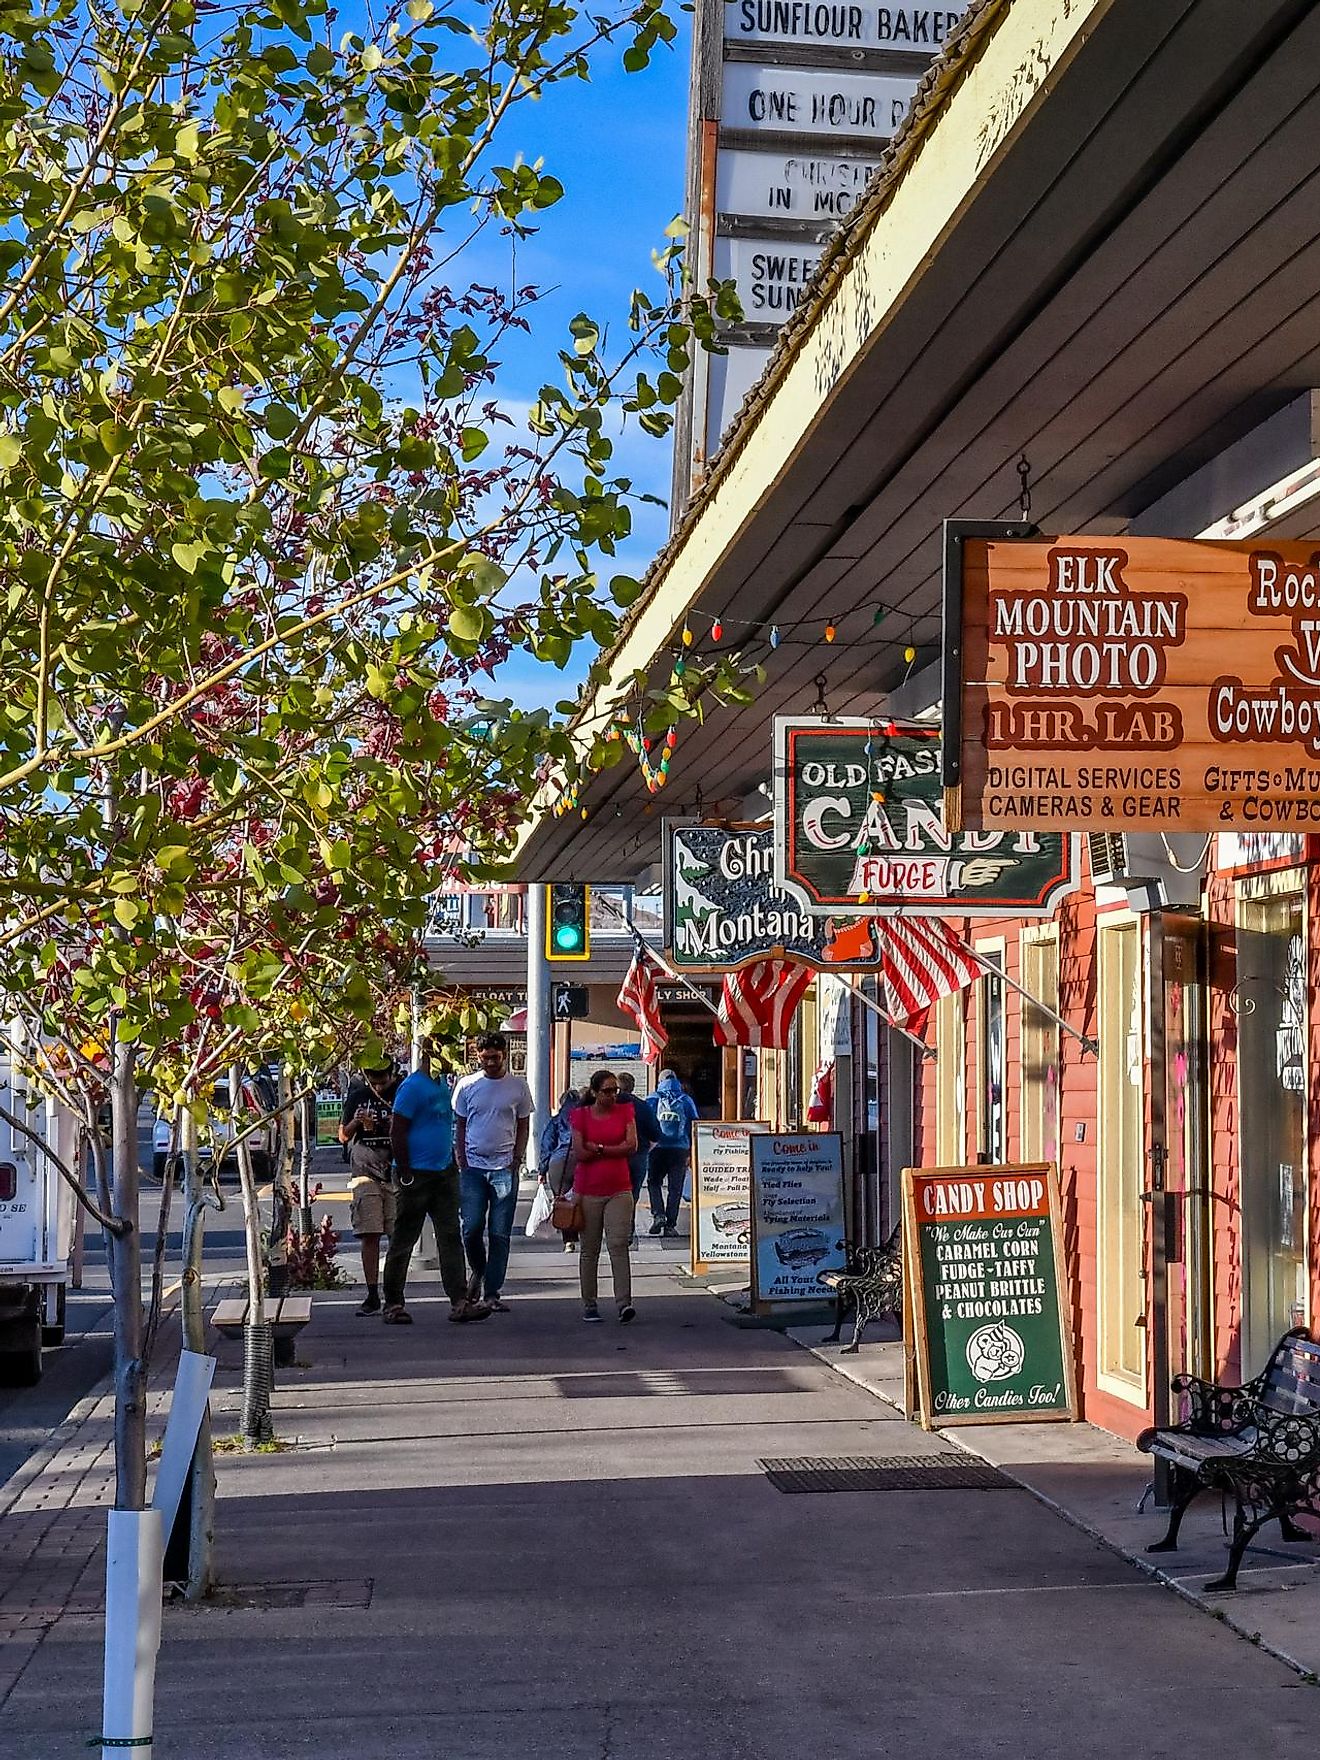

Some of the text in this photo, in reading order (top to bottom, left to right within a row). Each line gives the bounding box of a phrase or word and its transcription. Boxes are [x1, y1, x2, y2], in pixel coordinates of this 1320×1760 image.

[740, 0, 961, 44] SUNFLOUR BAKER
[749, 90, 798, 122] ONE
[812, 93, 875, 128] HOUR
[769, 187, 791, 210] IN
[1056, 556, 1120, 595] ELK
[994, 599, 1179, 638] MOUNTAIN
[1015, 642, 1158, 690] PHOTO
[990, 710, 1175, 743] 1 HR. LAB
[801, 762, 867, 788] OLD
[989, 767, 1182, 790] DIGITAL SERVICES
[1204, 767, 1271, 792] GIFTS
[989, 795, 1182, 818] CAMERAS & GEAR
[1219, 802, 1235, 823] &
[861, 861, 937, 890] FUDGE
[683, 902, 815, 958] Montana
[773, 1140, 807, 1155] Come
[702, 1166, 735, 1174] GUIDED
[777, 1197, 817, 1206] Selection
[923, 1179, 1044, 1215] CANDY SHOP
[953, 1223, 990, 1242] Make
[992, 1222, 1014, 1239] Our
[700, 1250, 749, 1259] Yellowstone
[711, 1242, 748, 1251] Montana
[936, 1239, 1040, 1262] CARAMEL CORN
[768, 1286, 806, 1296] Fishing
[774, 1275, 815, 1285] All Your
[934, 1278, 1046, 1300] PEANUT BRITTLE
[941, 1297, 1042, 1320] & CHOCOLATES
[934, 1382, 1061, 1411] Other Candies Too!
